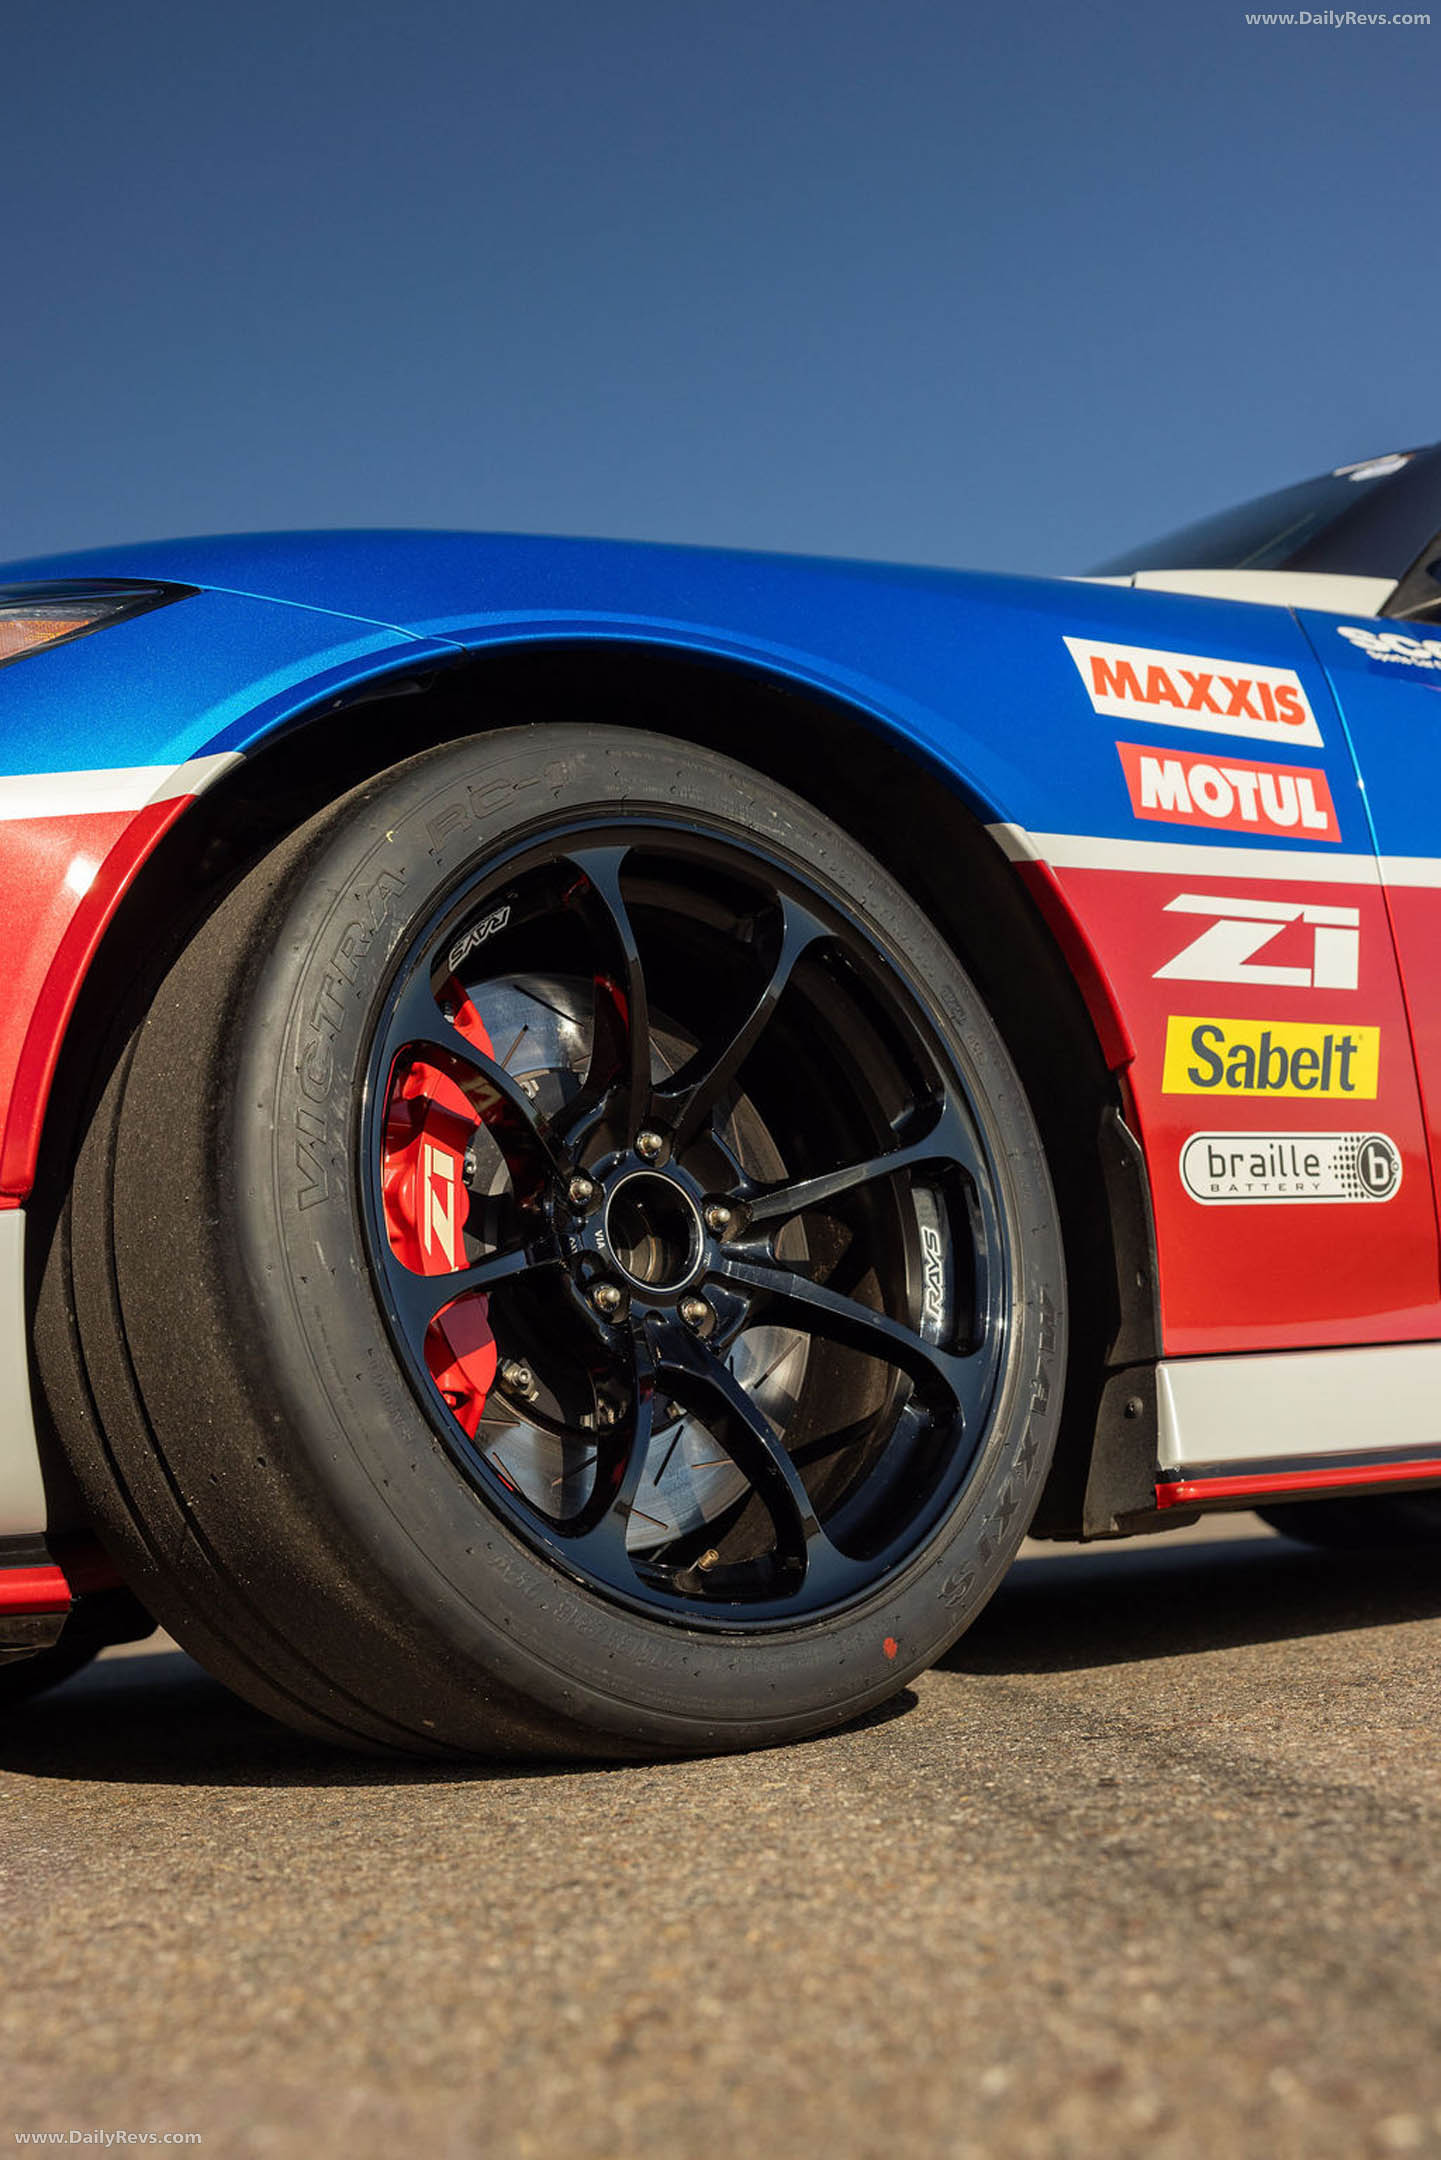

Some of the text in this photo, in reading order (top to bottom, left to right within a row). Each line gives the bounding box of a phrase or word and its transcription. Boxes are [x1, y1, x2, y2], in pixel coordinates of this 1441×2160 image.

[1089, 656, 1306, 726] MAXXIS
[1140, 756, 1329, 830] MOTUL
[295, 870, 408, 1212] VICTRA
[1186, 1024, 1358, 1092] Sabelt
[1207, 1143, 1321, 1178] braille
[1210, 1182, 1321, 1192] BATTERY
[921, 1226, 944, 1317] RAYS
